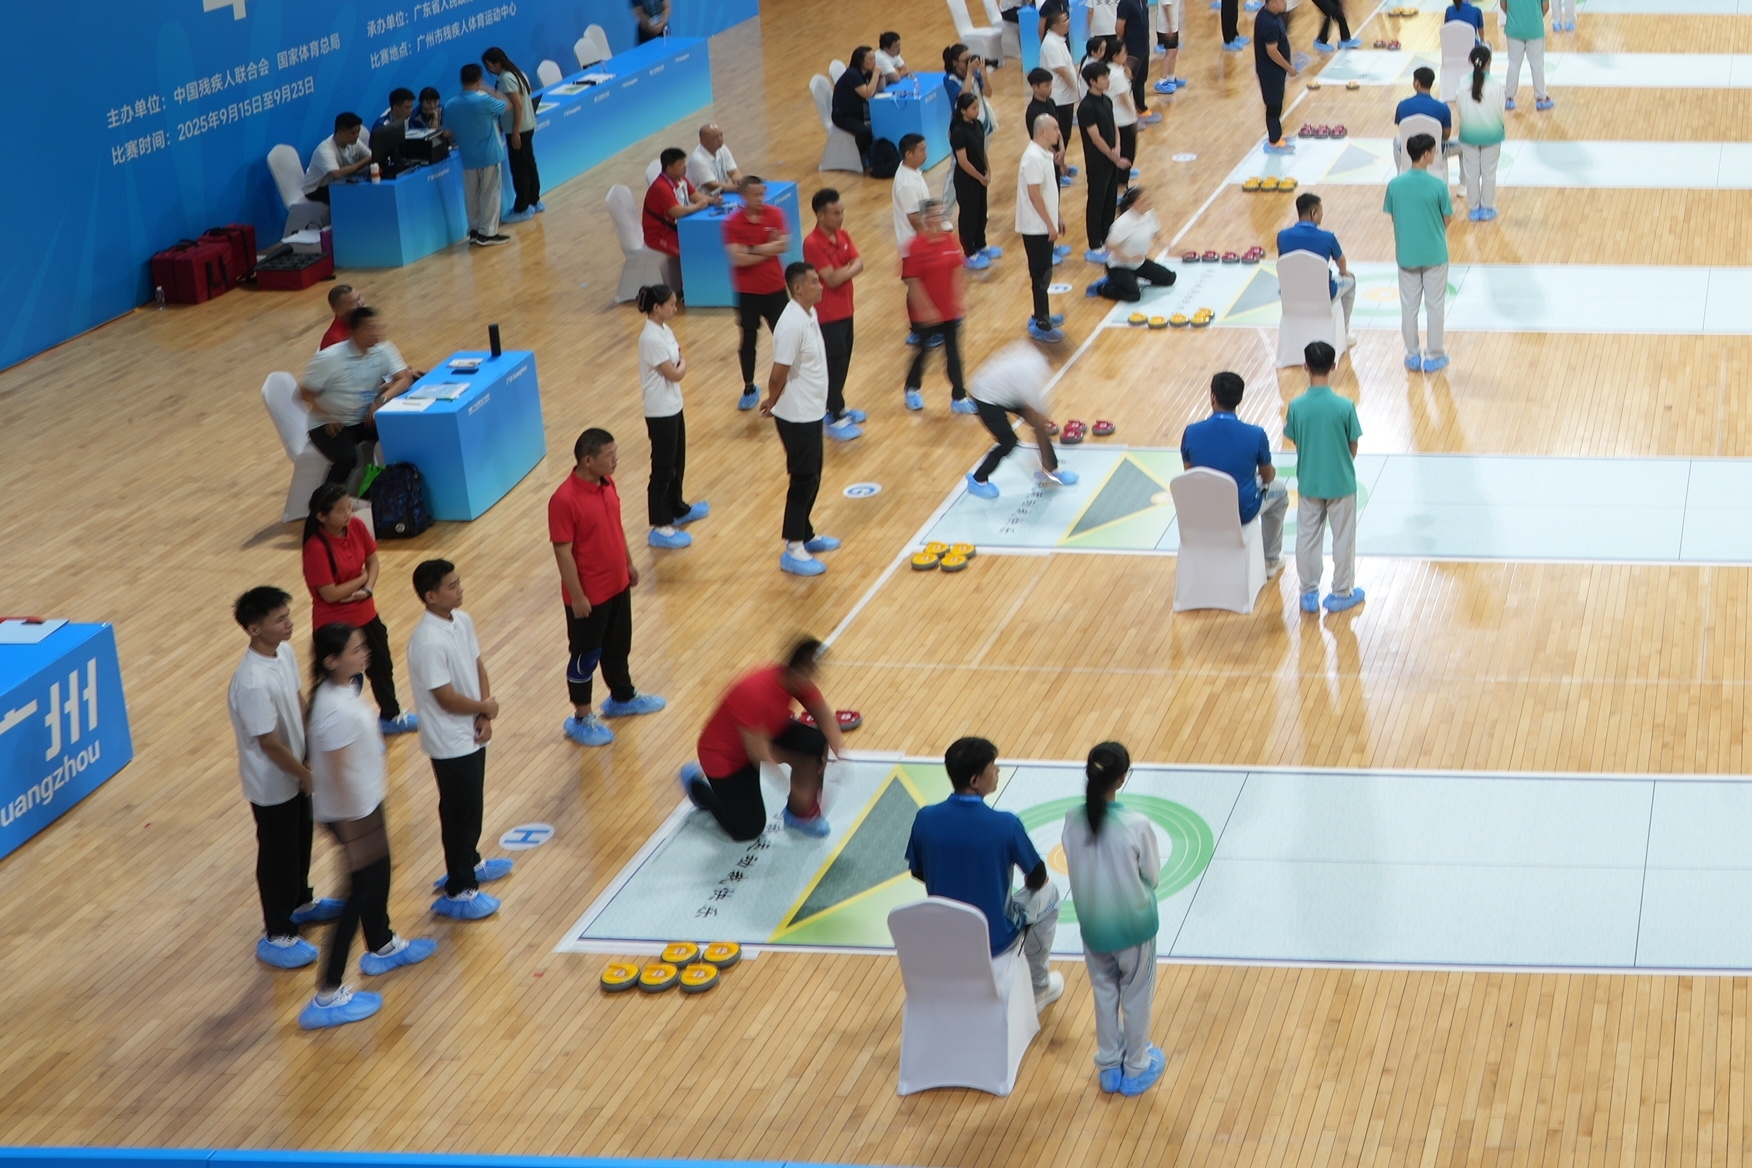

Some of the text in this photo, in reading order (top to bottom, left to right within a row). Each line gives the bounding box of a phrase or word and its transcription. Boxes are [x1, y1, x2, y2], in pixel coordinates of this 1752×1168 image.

[367, 11, 409, 37] 承办单位：
[370, 1, 517, 69] 比赛地点： 广州市残疾人体育运动中心
[106, 32, 341, 129] 主办单位： 中国残疾人联合会 国家体育总局
[111, 75, 315, 166] 比赛时间： 2025年9月15日至9月23日
[848, 486, 875, 496] G
[0, 656, 98, 762] 州
[0, 739, 100, 828] uangzhou
[503, 829, 549, 845] H
